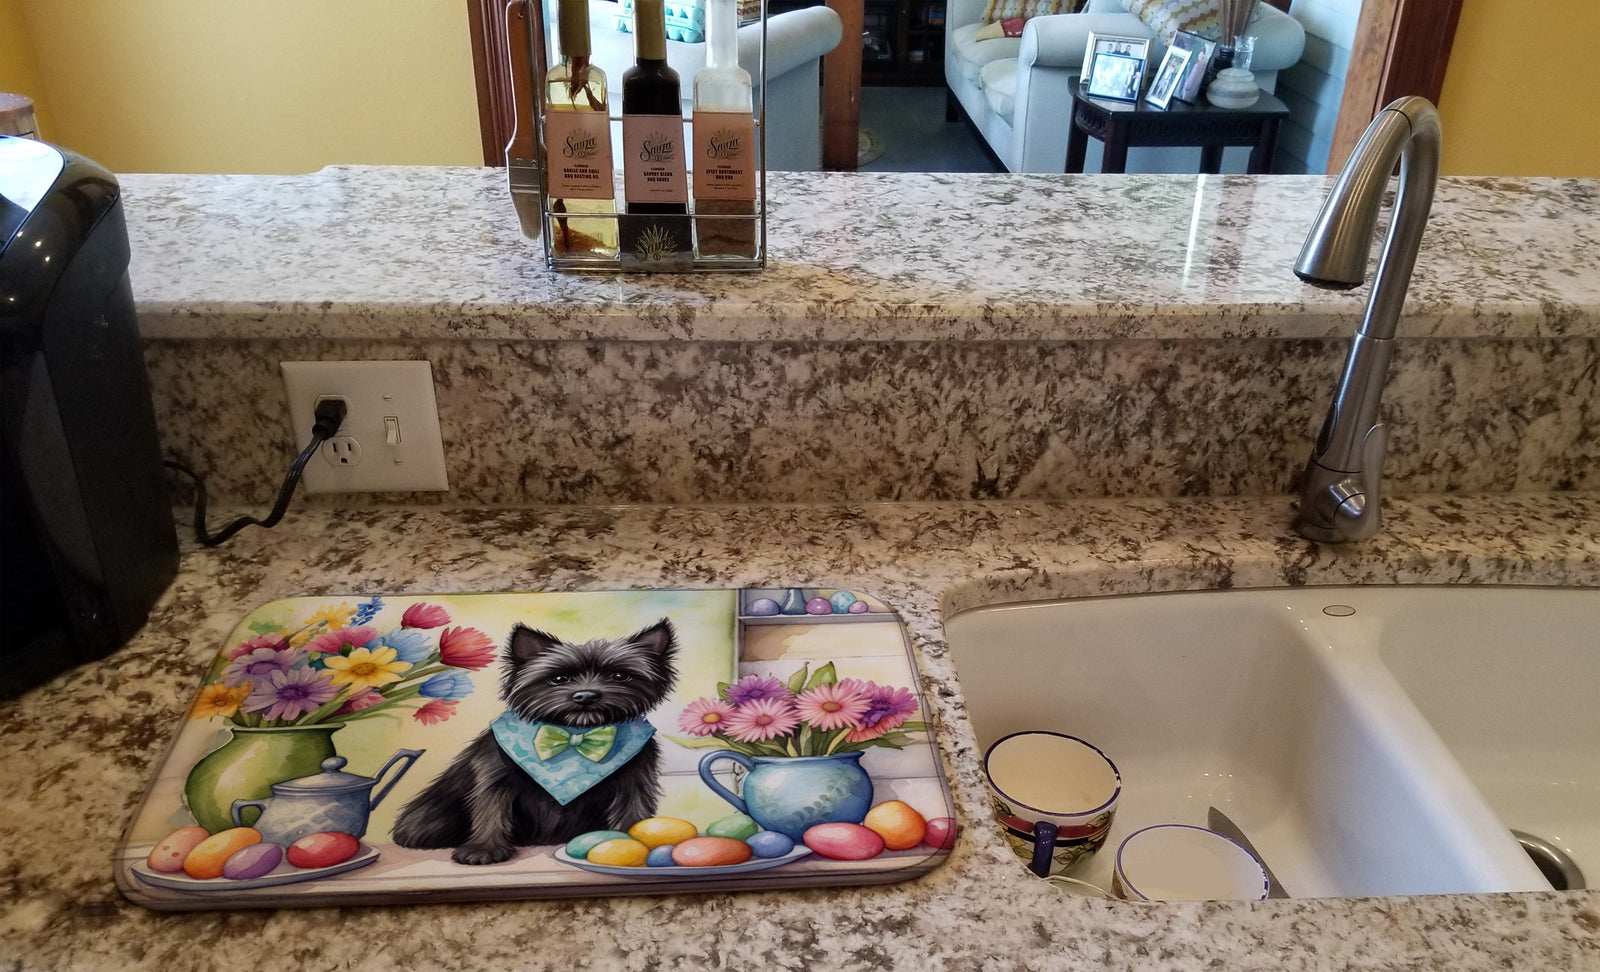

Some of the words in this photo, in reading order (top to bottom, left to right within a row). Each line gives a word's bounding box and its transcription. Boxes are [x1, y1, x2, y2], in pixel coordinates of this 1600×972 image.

[563, 135, 598, 158] Sauza
[640, 140, 673, 162] Sauza
[707, 136, 740, 158] Sauza
